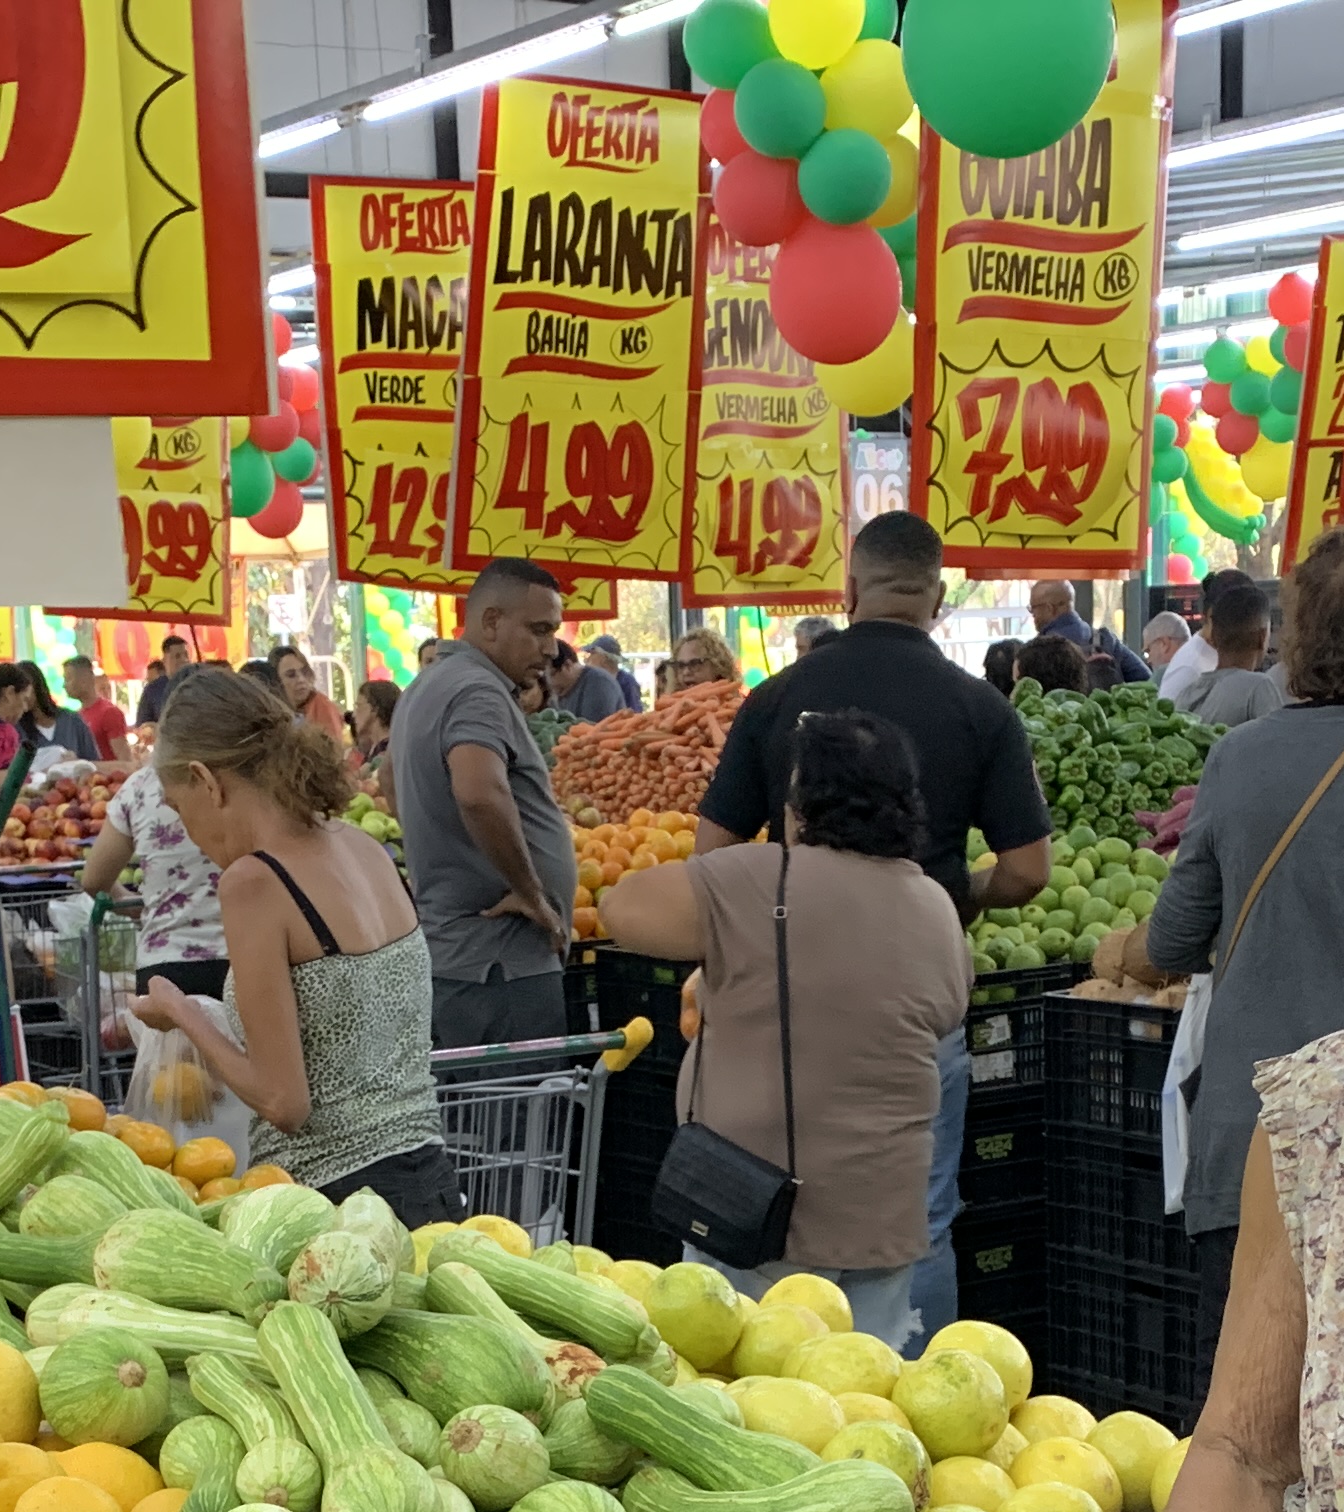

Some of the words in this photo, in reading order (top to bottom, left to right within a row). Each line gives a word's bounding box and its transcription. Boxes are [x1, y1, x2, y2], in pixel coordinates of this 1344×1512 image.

[546, 91, 660, 167] OFERTA
[359, 191, 471, 253] OFERTA
[493, 186, 693, 300] LARANJA
[967, 245, 1085, 304] VERMELHA
[619, 326, 648, 357] KG
[364, 370, 426, 405] VERDE
[714, 392, 799, 426] VERMELHA
[493, 411, 655, 541] 4,99
[956, 376, 1111, 527] 7,99
[713, 473, 823, 578] 4,99
